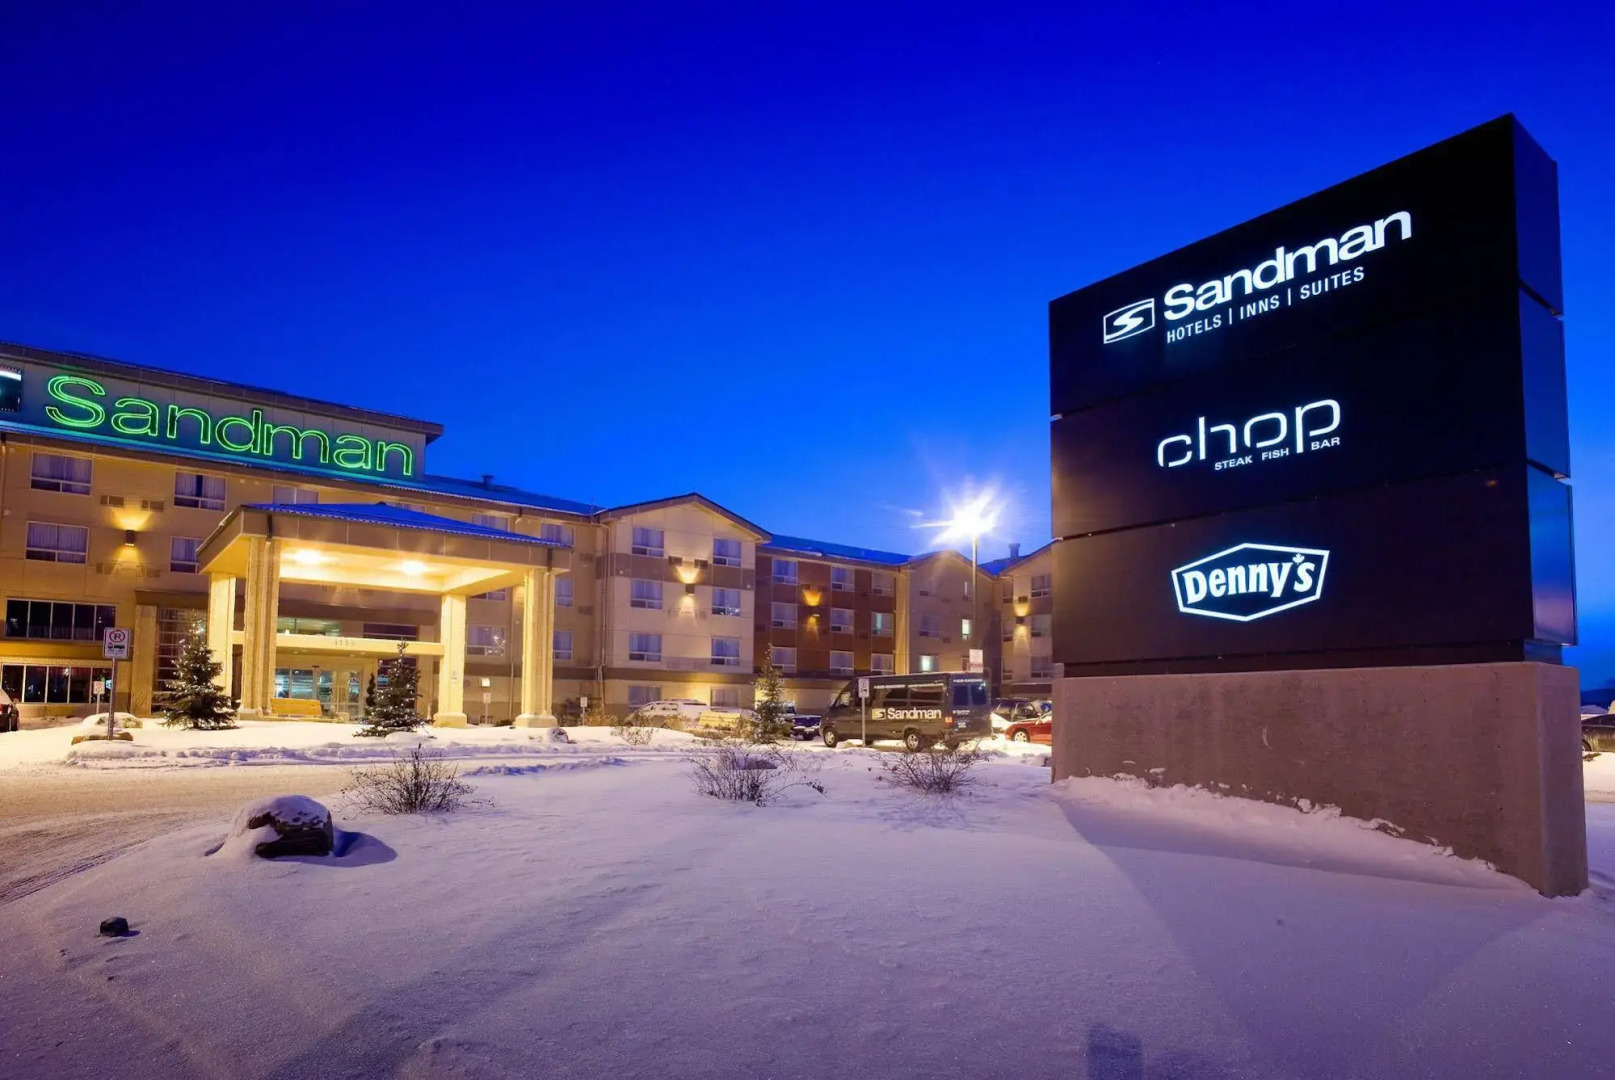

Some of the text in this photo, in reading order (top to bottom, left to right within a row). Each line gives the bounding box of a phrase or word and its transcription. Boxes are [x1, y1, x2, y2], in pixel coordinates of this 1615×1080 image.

[1163, 210, 1412, 320] Sandman
[1166, 266, 1365, 344] HOTELS INNS SUITES
[45, 375, 413, 476] Sandman
[1157, 399, 1341, 468] chop
[1214, 436, 1341, 471] STEAK FISH BAR
[1181, 553, 1315, 605] Denny's
[887, 707, 942, 720] Sandman
